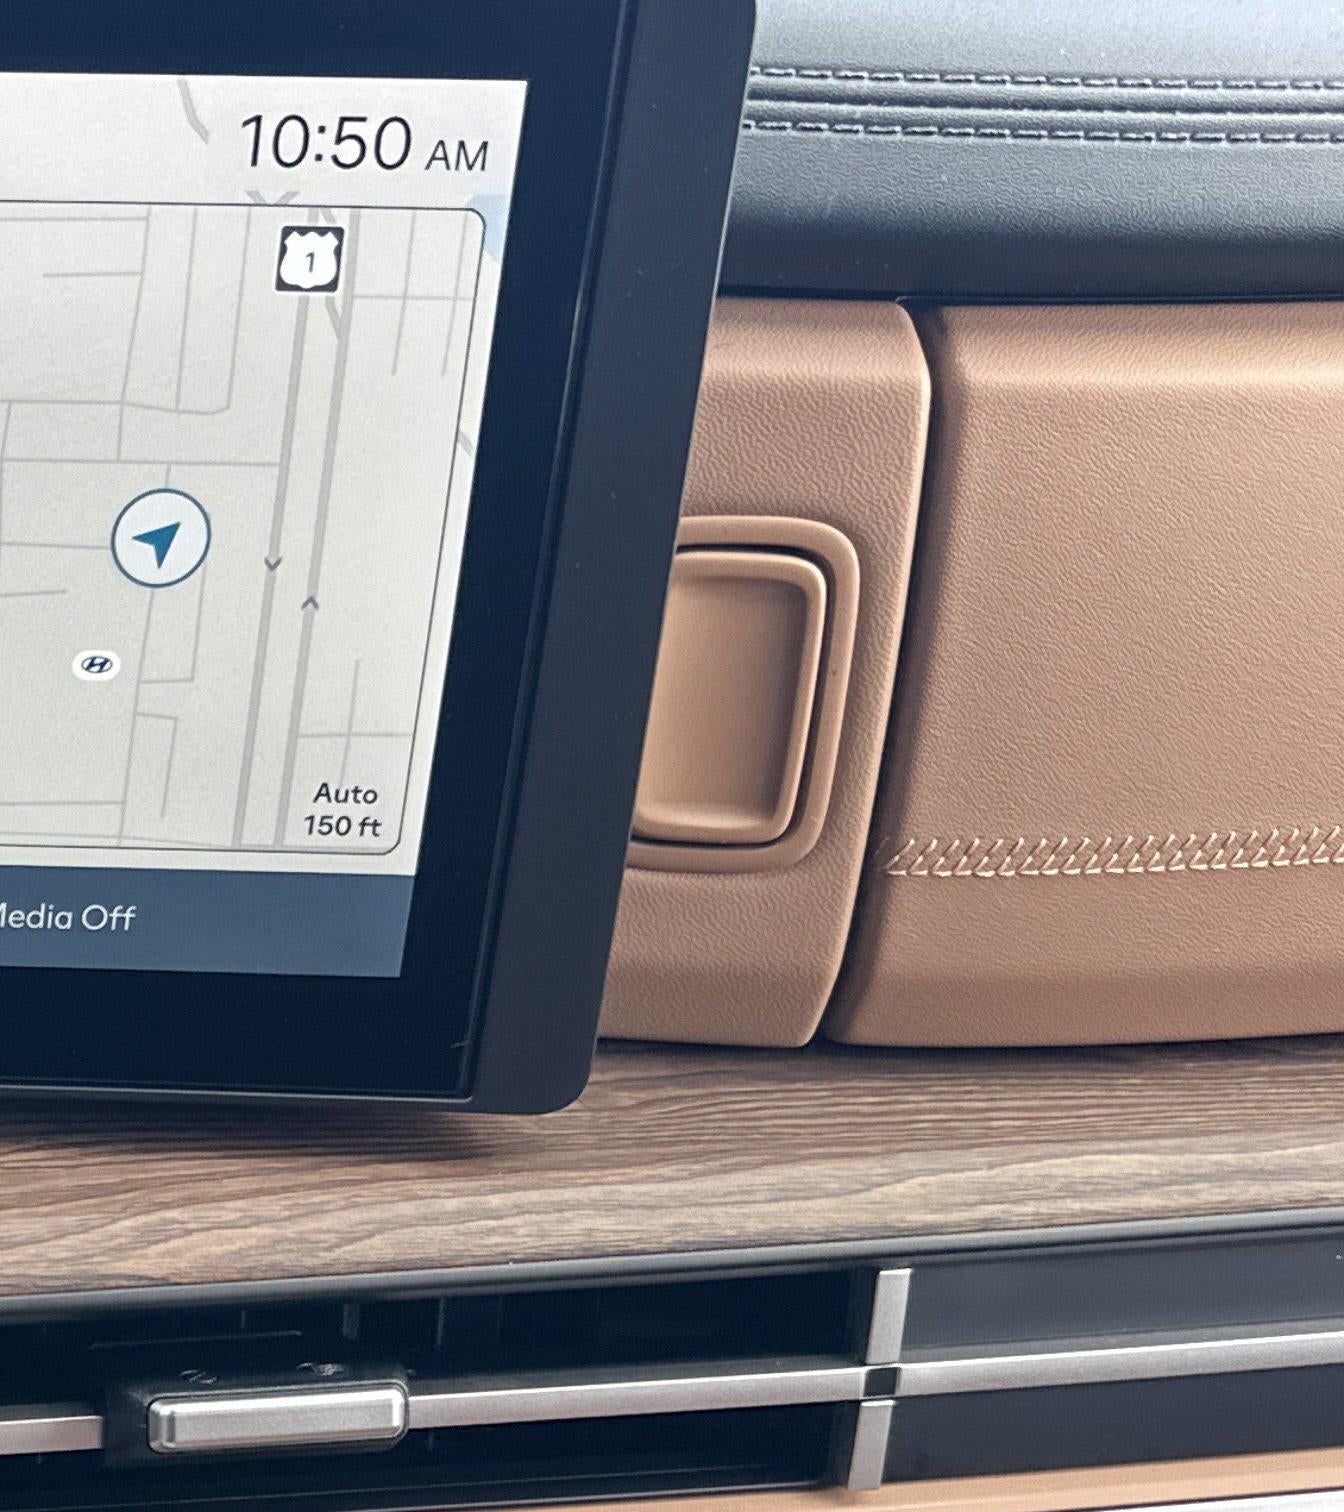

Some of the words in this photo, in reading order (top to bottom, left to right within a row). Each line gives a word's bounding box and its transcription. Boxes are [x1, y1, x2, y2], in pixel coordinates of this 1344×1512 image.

[241, 114, 412, 171] 10:50
[424, 139, 489, 172] AM
[303, 250, 317, 275] 1
[312, 782, 378, 805] Auto
[304, 814, 352, 837] 150
[357, 816, 383, 838] ft
[81, 904, 137, 931] Off
